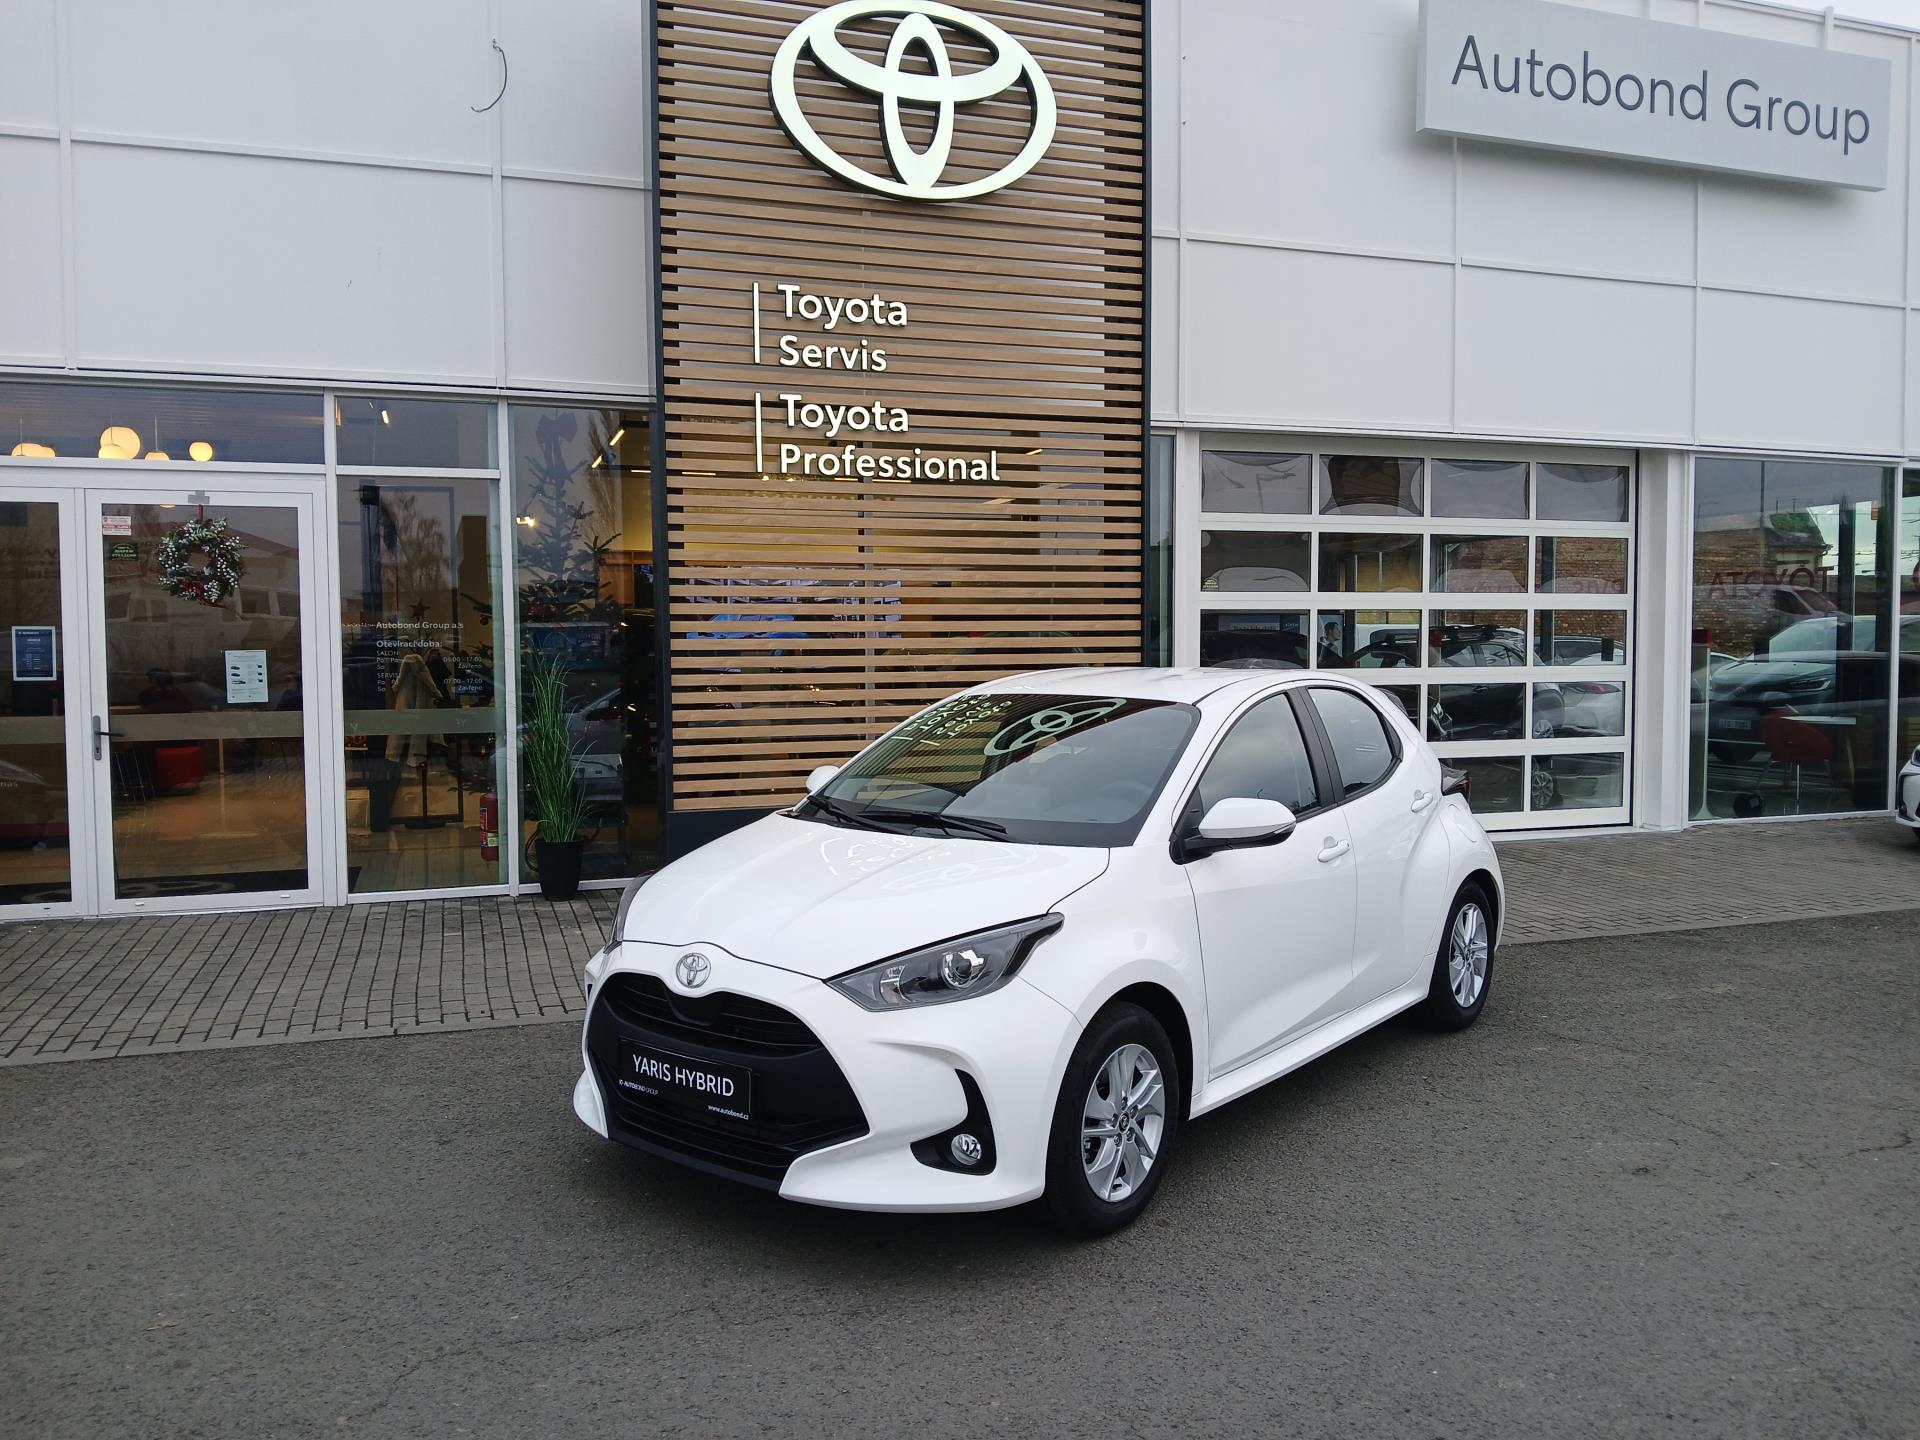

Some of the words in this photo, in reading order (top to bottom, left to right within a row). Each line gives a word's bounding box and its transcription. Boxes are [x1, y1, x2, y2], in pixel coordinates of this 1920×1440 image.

[1451, 35, 1708, 122] Autobond
[1726, 78, 1870, 155] Group
[777, 284, 908, 330] Toyota
[779, 335, 887, 372] Servis
[779, 393, 909, 437] Toyota
[780, 443, 1000, 481] Professional
[376, 621, 420, 629] Autobond
[422, 621, 449, 630] Group
[417, 640, 443, 648] doba:
[632, 1054, 671, 1082] YARIS
[675, 1066, 734, 1097] HYBRID
